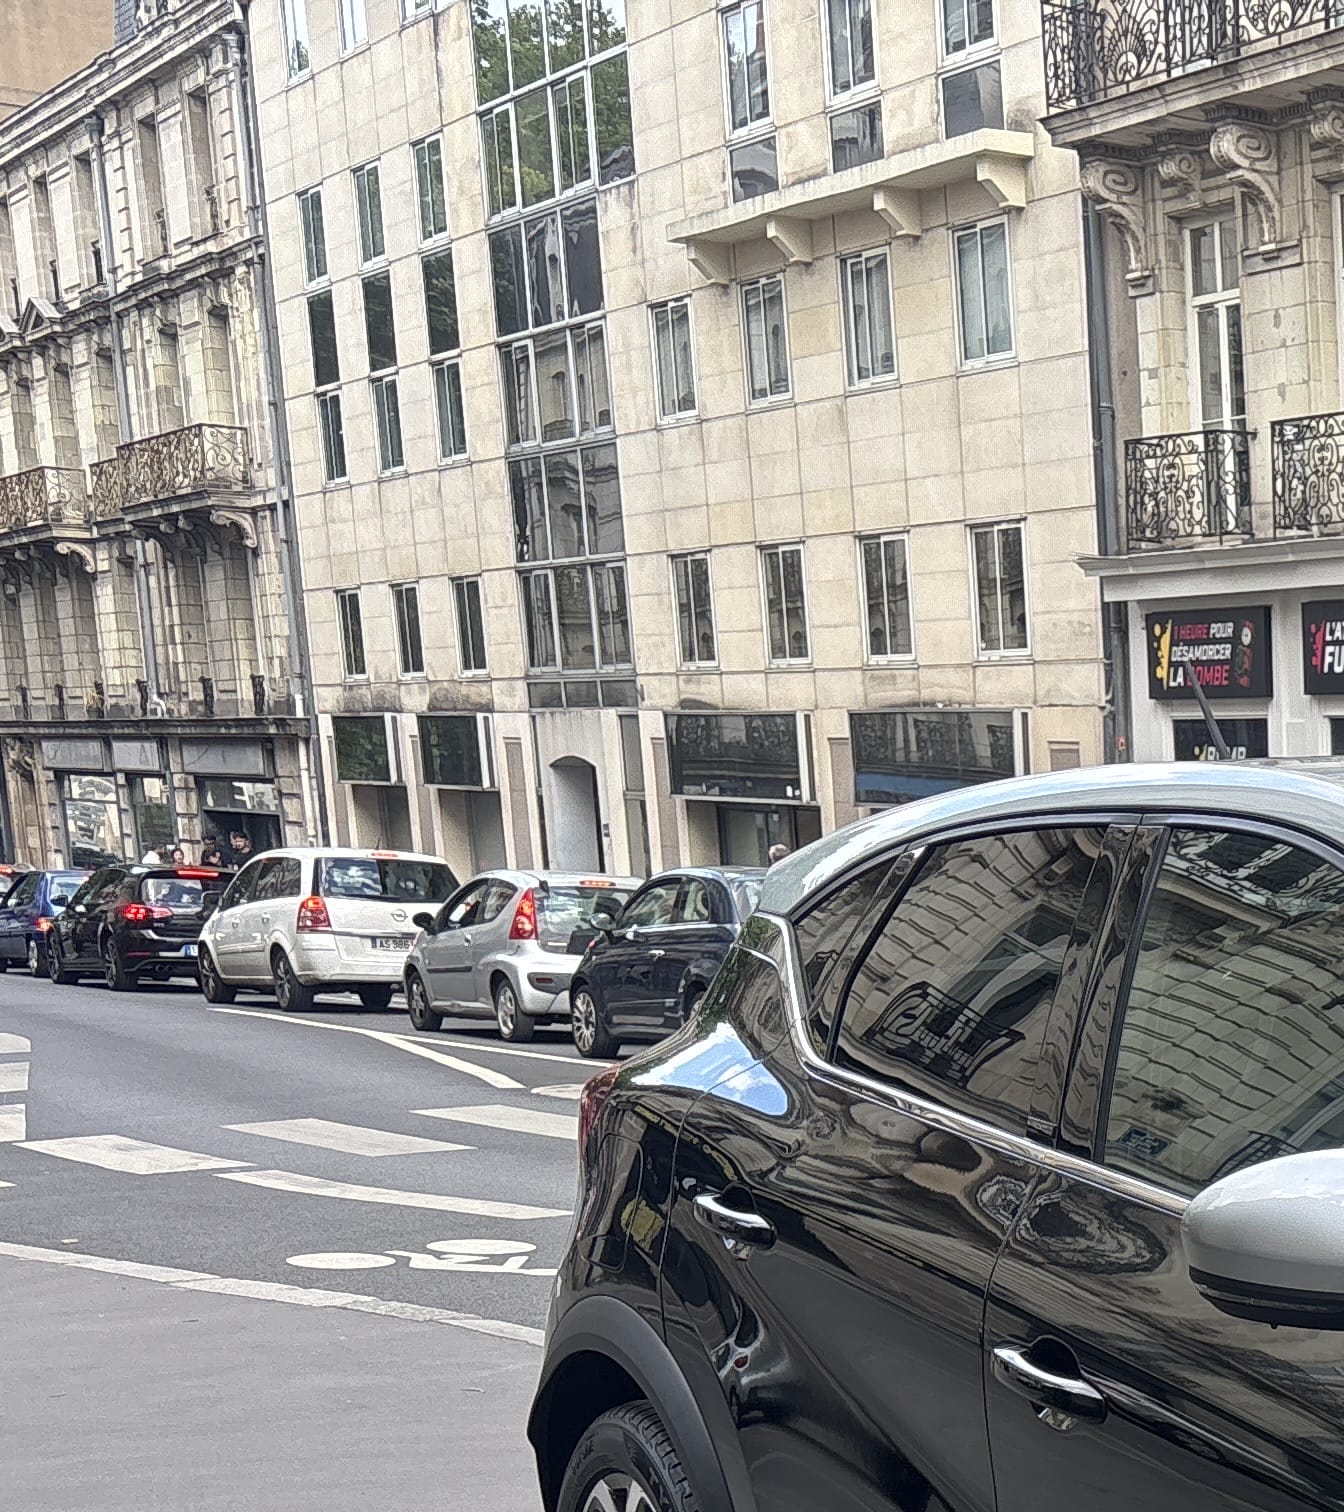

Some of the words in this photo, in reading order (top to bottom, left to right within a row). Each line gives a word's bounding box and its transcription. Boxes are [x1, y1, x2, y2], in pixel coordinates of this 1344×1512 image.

[1179, 624, 1209, 640] HEURE
[1209, 622, 1234, 639] POUR
[1171, 642, 1232, 662] DÉSAMORCER
[1169, 666, 1185, 687] LA
